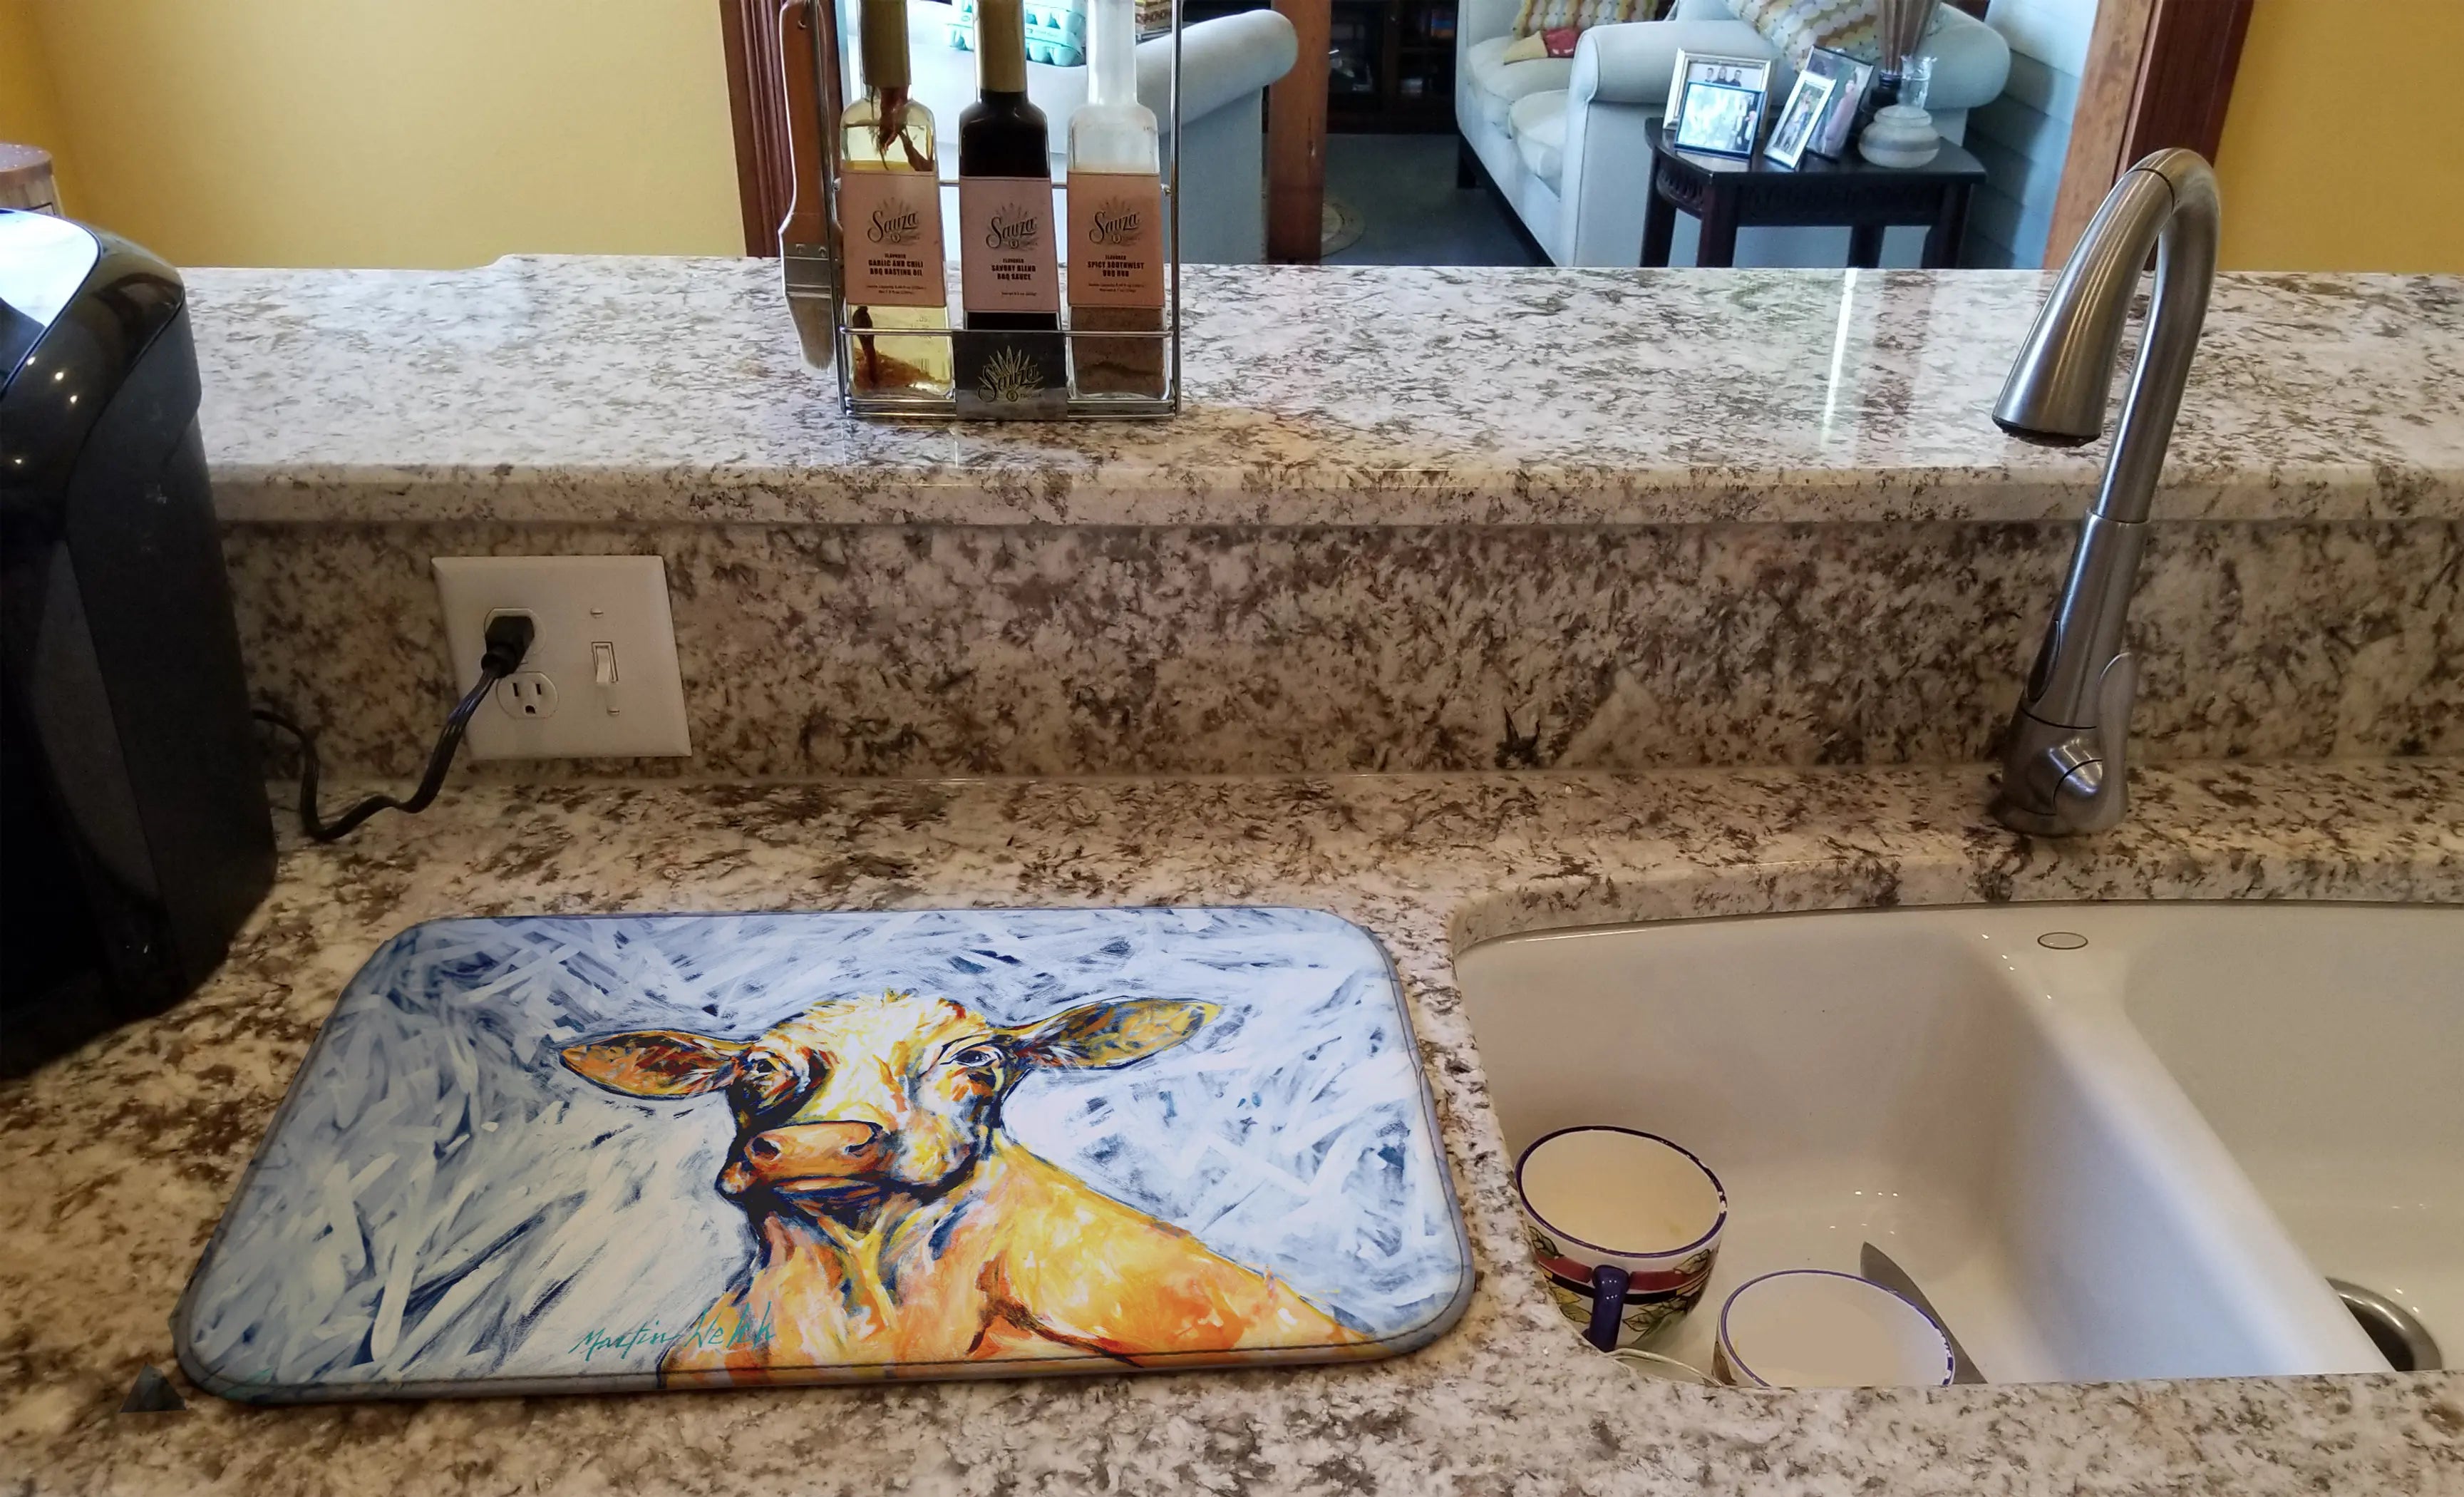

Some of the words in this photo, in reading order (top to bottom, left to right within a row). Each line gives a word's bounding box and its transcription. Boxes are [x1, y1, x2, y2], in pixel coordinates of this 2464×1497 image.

[867, 210, 918, 243] Sauza
[986, 216, 1037, 249] Sauza
[1088, 211, 1140, 244] Sauza
[976, 364, 1043, 403] Sauza
[568, 1321, 681, 1362] Martin
